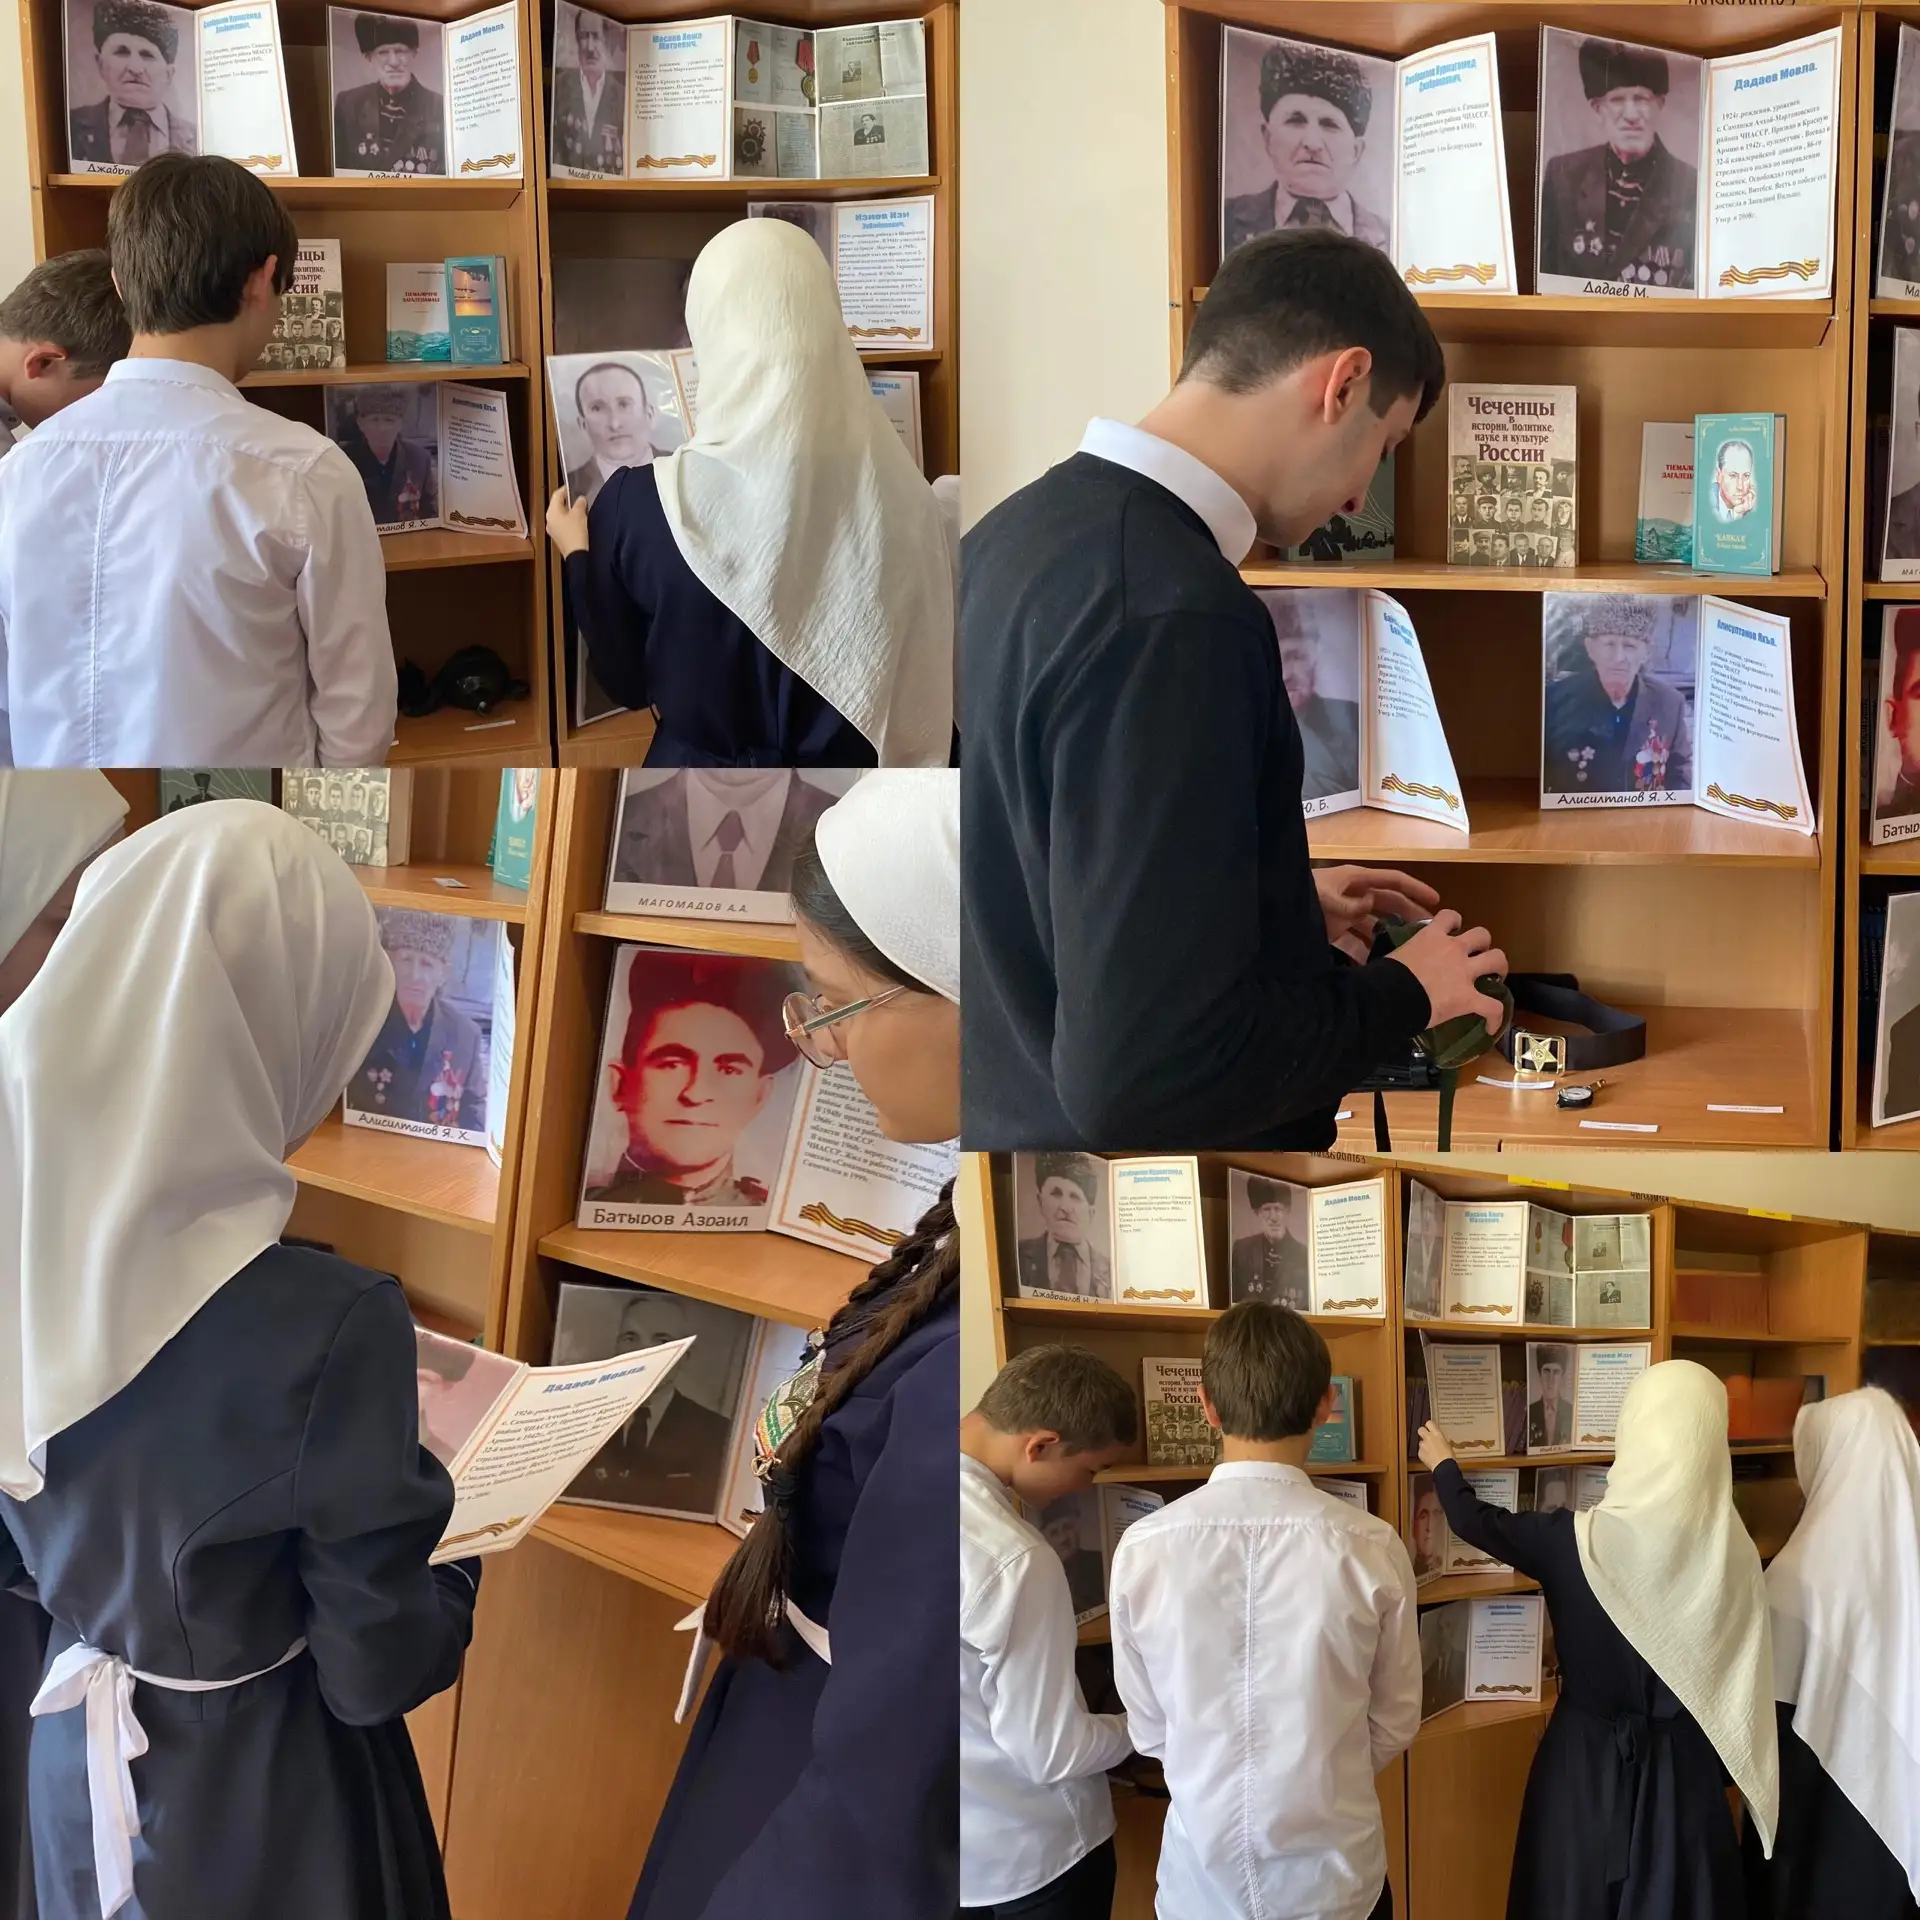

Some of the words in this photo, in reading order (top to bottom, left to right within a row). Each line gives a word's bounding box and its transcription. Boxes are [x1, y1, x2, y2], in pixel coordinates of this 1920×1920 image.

[1734, 75, 1778, 91] Дадаев
[1780, 62, 1818, 80] Мовла.
[1723, 121, 1754, 132] Самашки
[1771, 123, 1797, 136] Призван
[1802, 114, 1829, 128] Красную
[1717, 145, 1740, 156] Армию
[1805, 128, 1826, 139] Воевал
[1716, 156, 1730, 166] 32-й
[1716, 167, 1753, 178] стрелкового
[1754, 163, 1772, 172] полка
[1748, 170, 1785, 183] Освобождал
[1785, 167, 1805, 179] города
[1715, 215, 1731, 224] Умер
[1584, 281, 1630, 296] Дадаев
[1634, 287, 1650, 298] М.
[1468, 397, 1556, 419] Чеченцы
[1472, 422, 1509, 433] истории,
[1512, 424, 1555, 433] политике,
[1509, 416, 1515, 424] в
[1474, 434, 1500, 444] науке
[1502, 434, 1508, 442] и
[1510, 434, 1549, 444] культуре
[1478, 444, 1545, 462] России
[1320, 798, 1329, 811] Б.
[1558, 792, 1645, 805] Алисилтанов
[1648, 792, 1661, 802] Я.
[1664, 792, 1677, 801] Х.
[638, 898, 722, 912] МАГОМАДОВ
[358, 1113, 439, 1137] Алисилтанов
[442, 1128, 454, 1139] Я.
[458, 1130, 471, 1141] Х.
[594, 1208, 675, 1226] Батыров
[682, 1212, 749, 1227] Азраил
[542, 1378, 597, 1394] Дадаев
